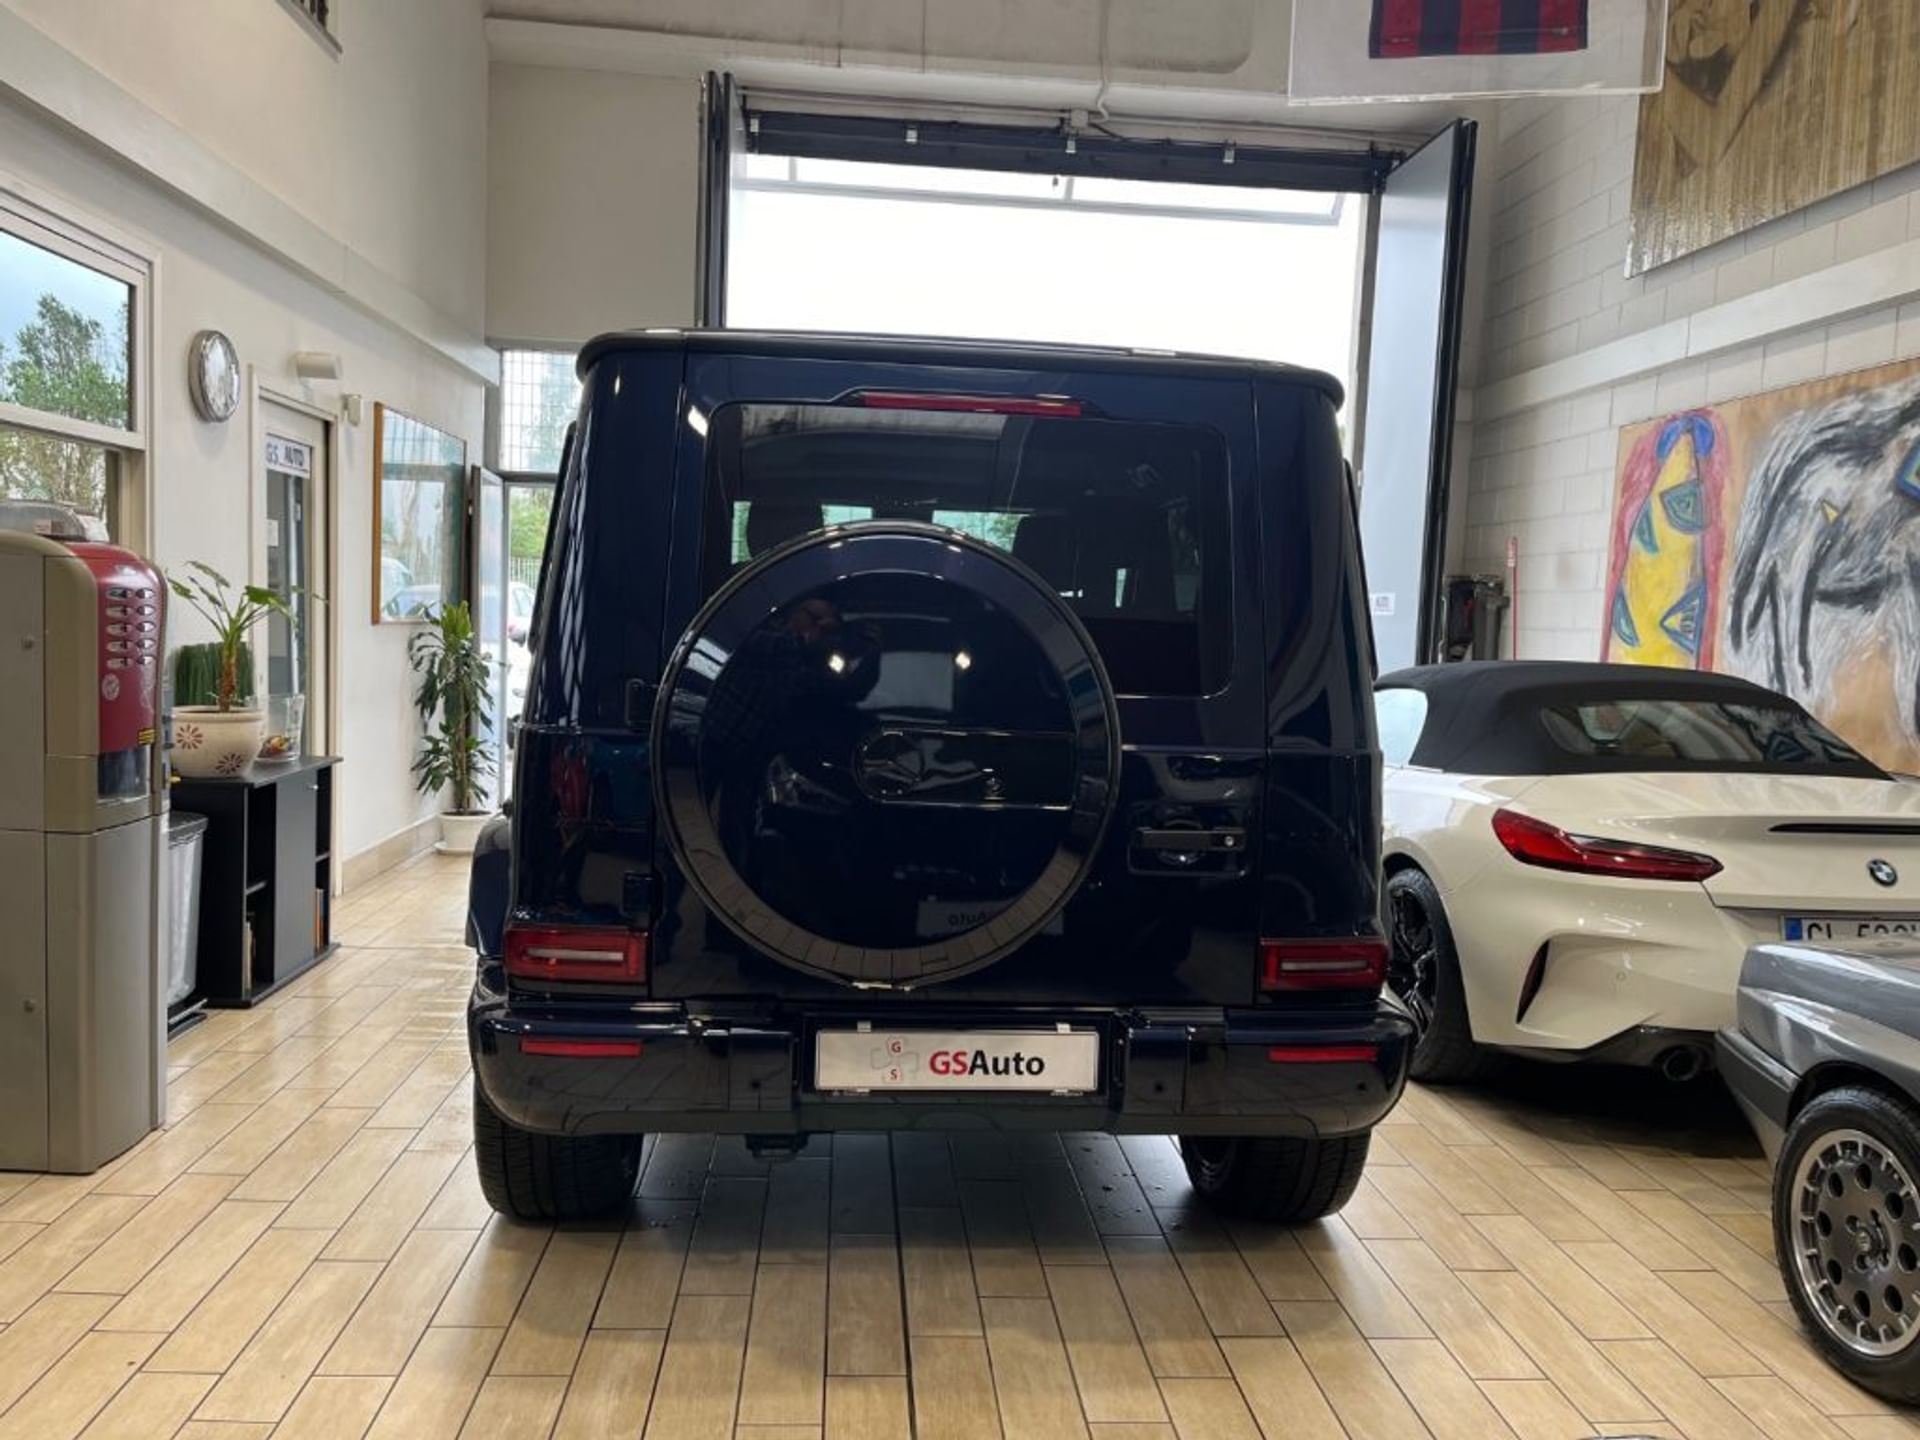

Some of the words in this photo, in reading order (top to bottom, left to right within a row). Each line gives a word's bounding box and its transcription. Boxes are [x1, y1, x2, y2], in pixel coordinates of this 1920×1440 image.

[891, 1041, 902, 1053] G
[929, 1049, 1045, 1076] GSAuto
[890, 1068, 898, 1081] S
